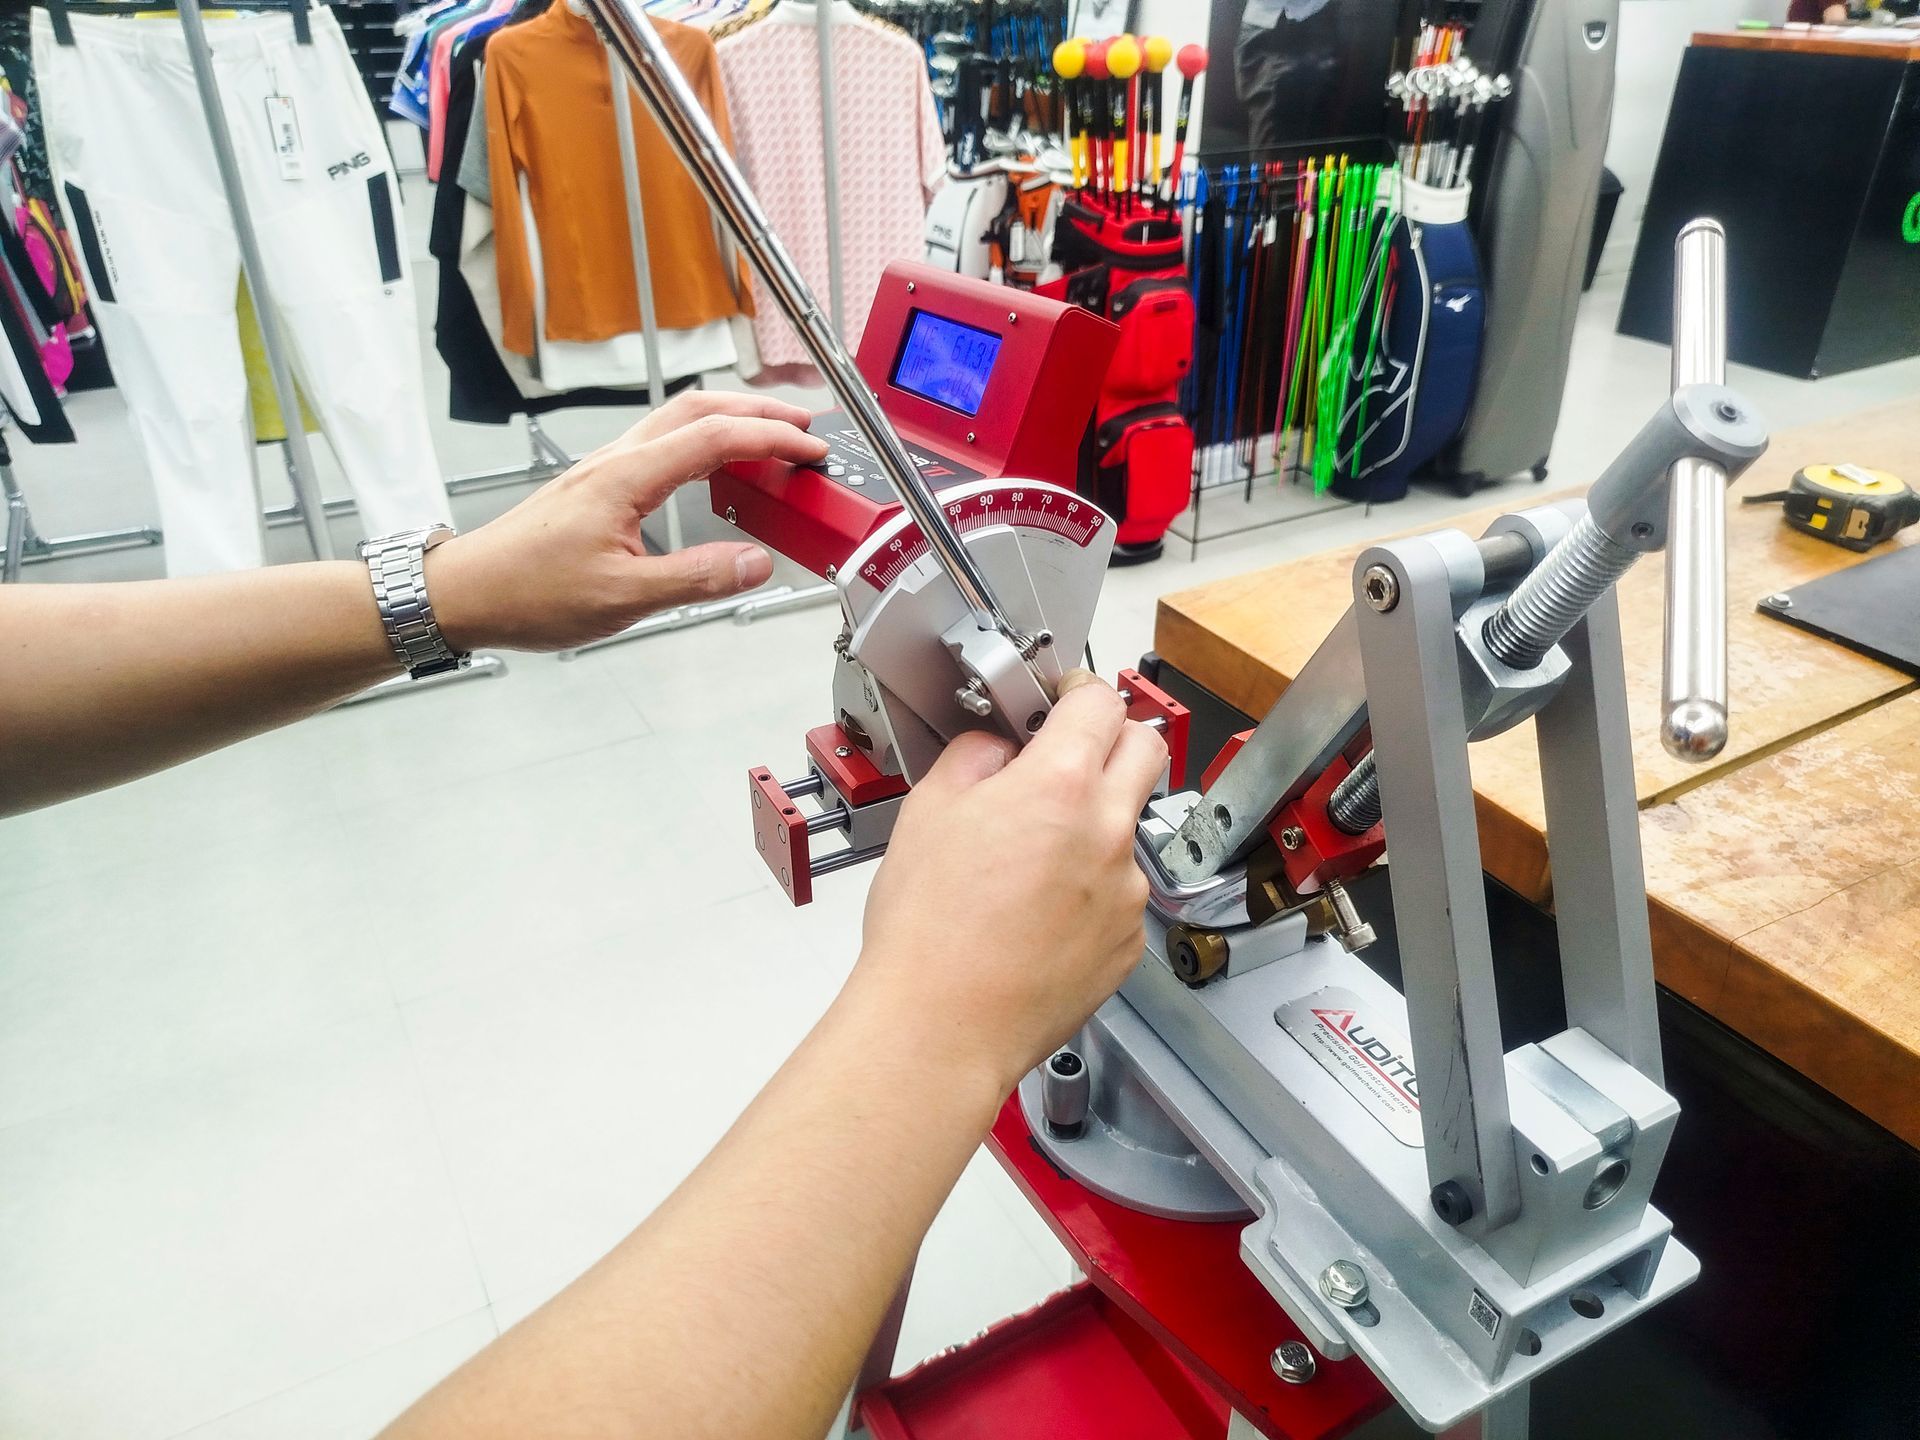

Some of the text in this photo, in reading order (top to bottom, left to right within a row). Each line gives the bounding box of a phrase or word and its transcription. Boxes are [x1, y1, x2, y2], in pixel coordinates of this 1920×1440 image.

[327, 152, 371, 181] PING
[864, 492, 1102, 577] 50 60 80 90 80 70 60 50
[1315, 1023, 1350, 1055] Precision
[1348, 1054, 1367, 1069] Golf
